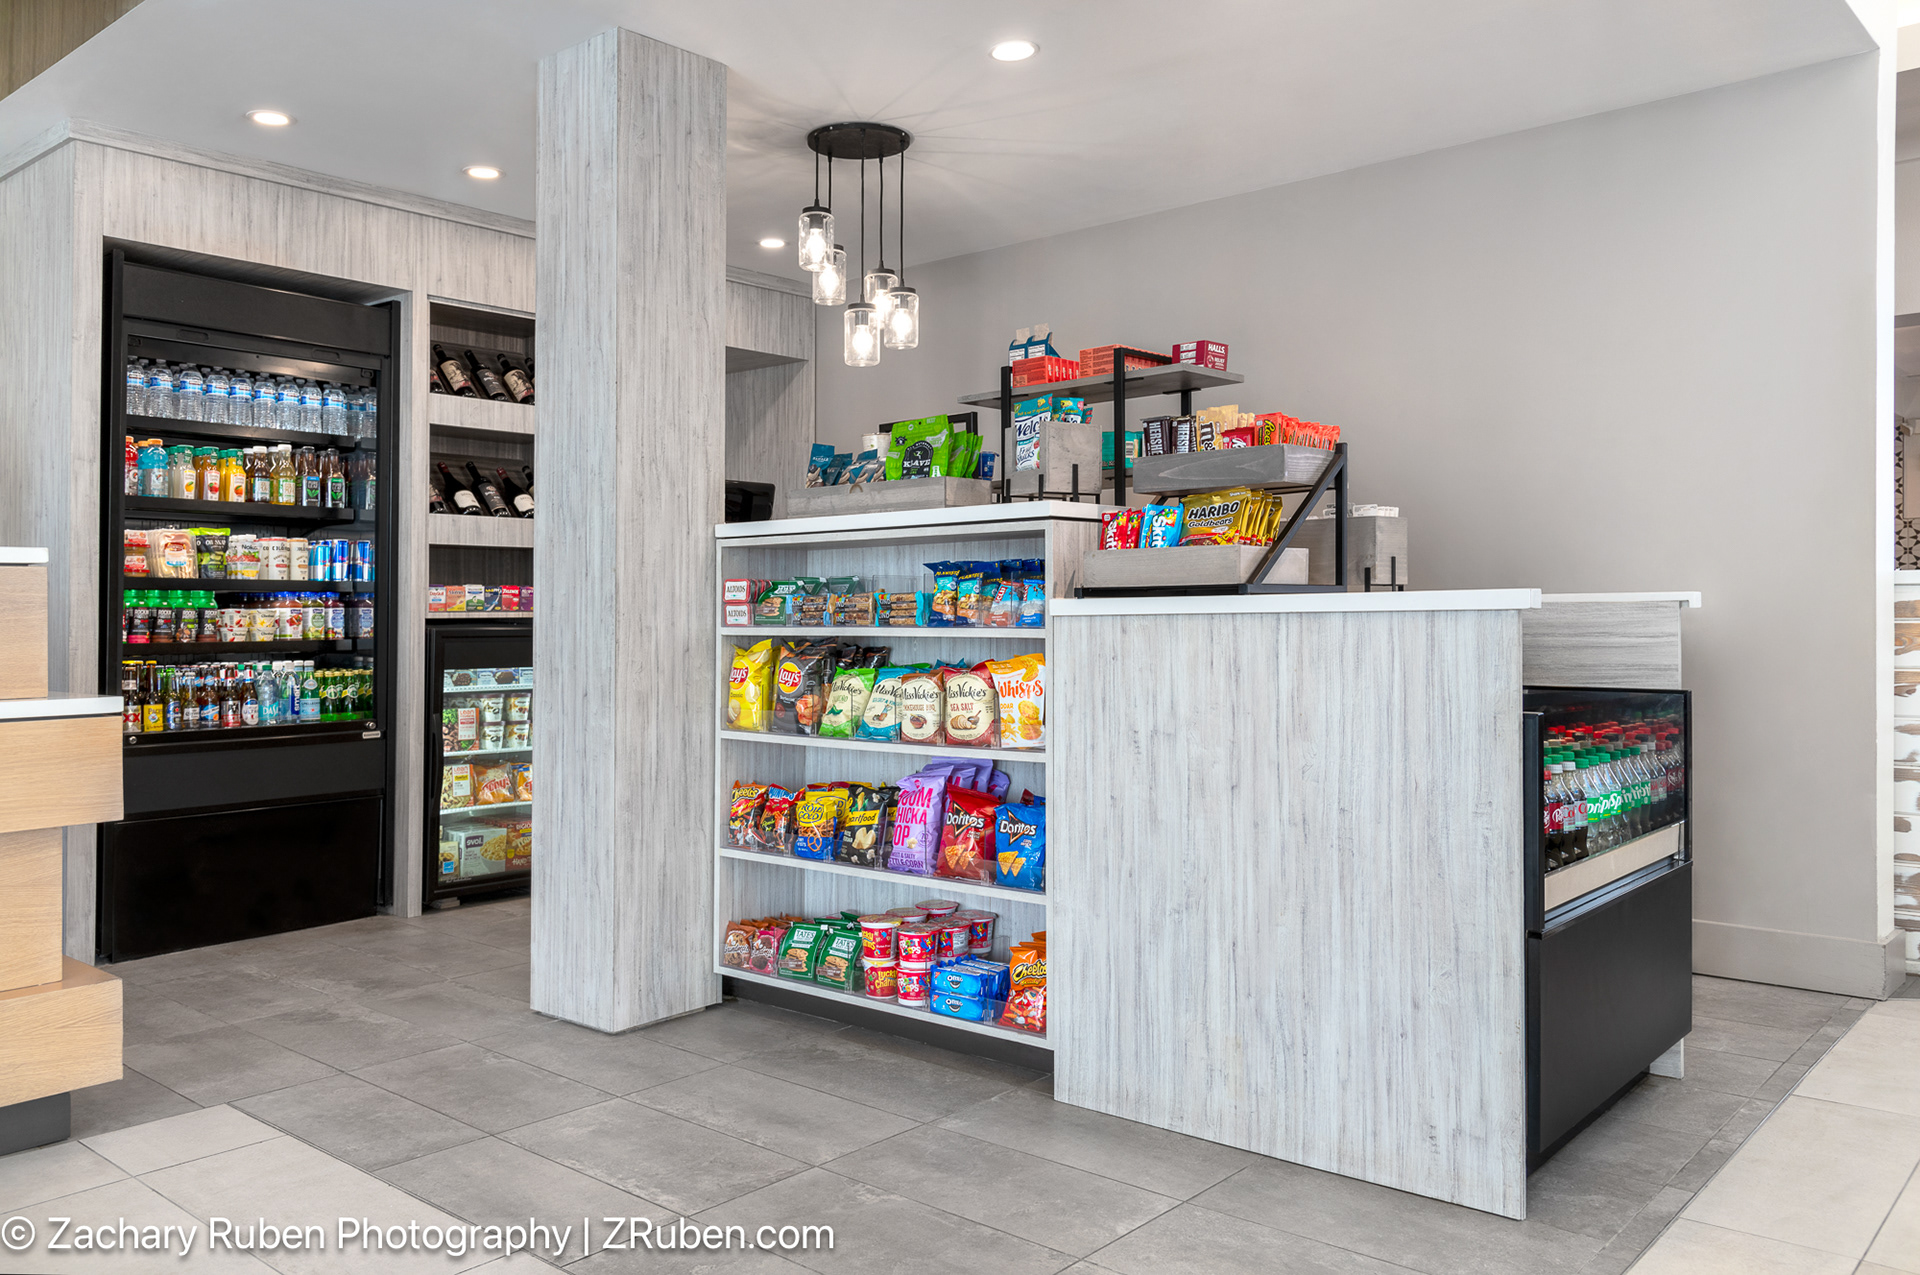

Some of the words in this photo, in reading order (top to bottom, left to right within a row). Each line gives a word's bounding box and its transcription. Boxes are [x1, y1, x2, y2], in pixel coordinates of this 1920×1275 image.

[1187, 500, 1241, 520] HARIBO
[1188, 517, 1234, 529] Goldbears
[726, 585, 746, 593] ALTOIDS
[727, 609, 747, 617] ALTOIDS
[778, 670, 802, 687] Lay's
[914, 683, 939, 702] Vickie's
[957, 681, 988, 701] Vickie's
[961, 703, 974, 711] SALT
[946, 812, 985, 829] Doritos
[1000, 820, 1037, 836] Doritos
[947, 974, 963, 983] OREO
[945, 998, 963, 1007] OREO
